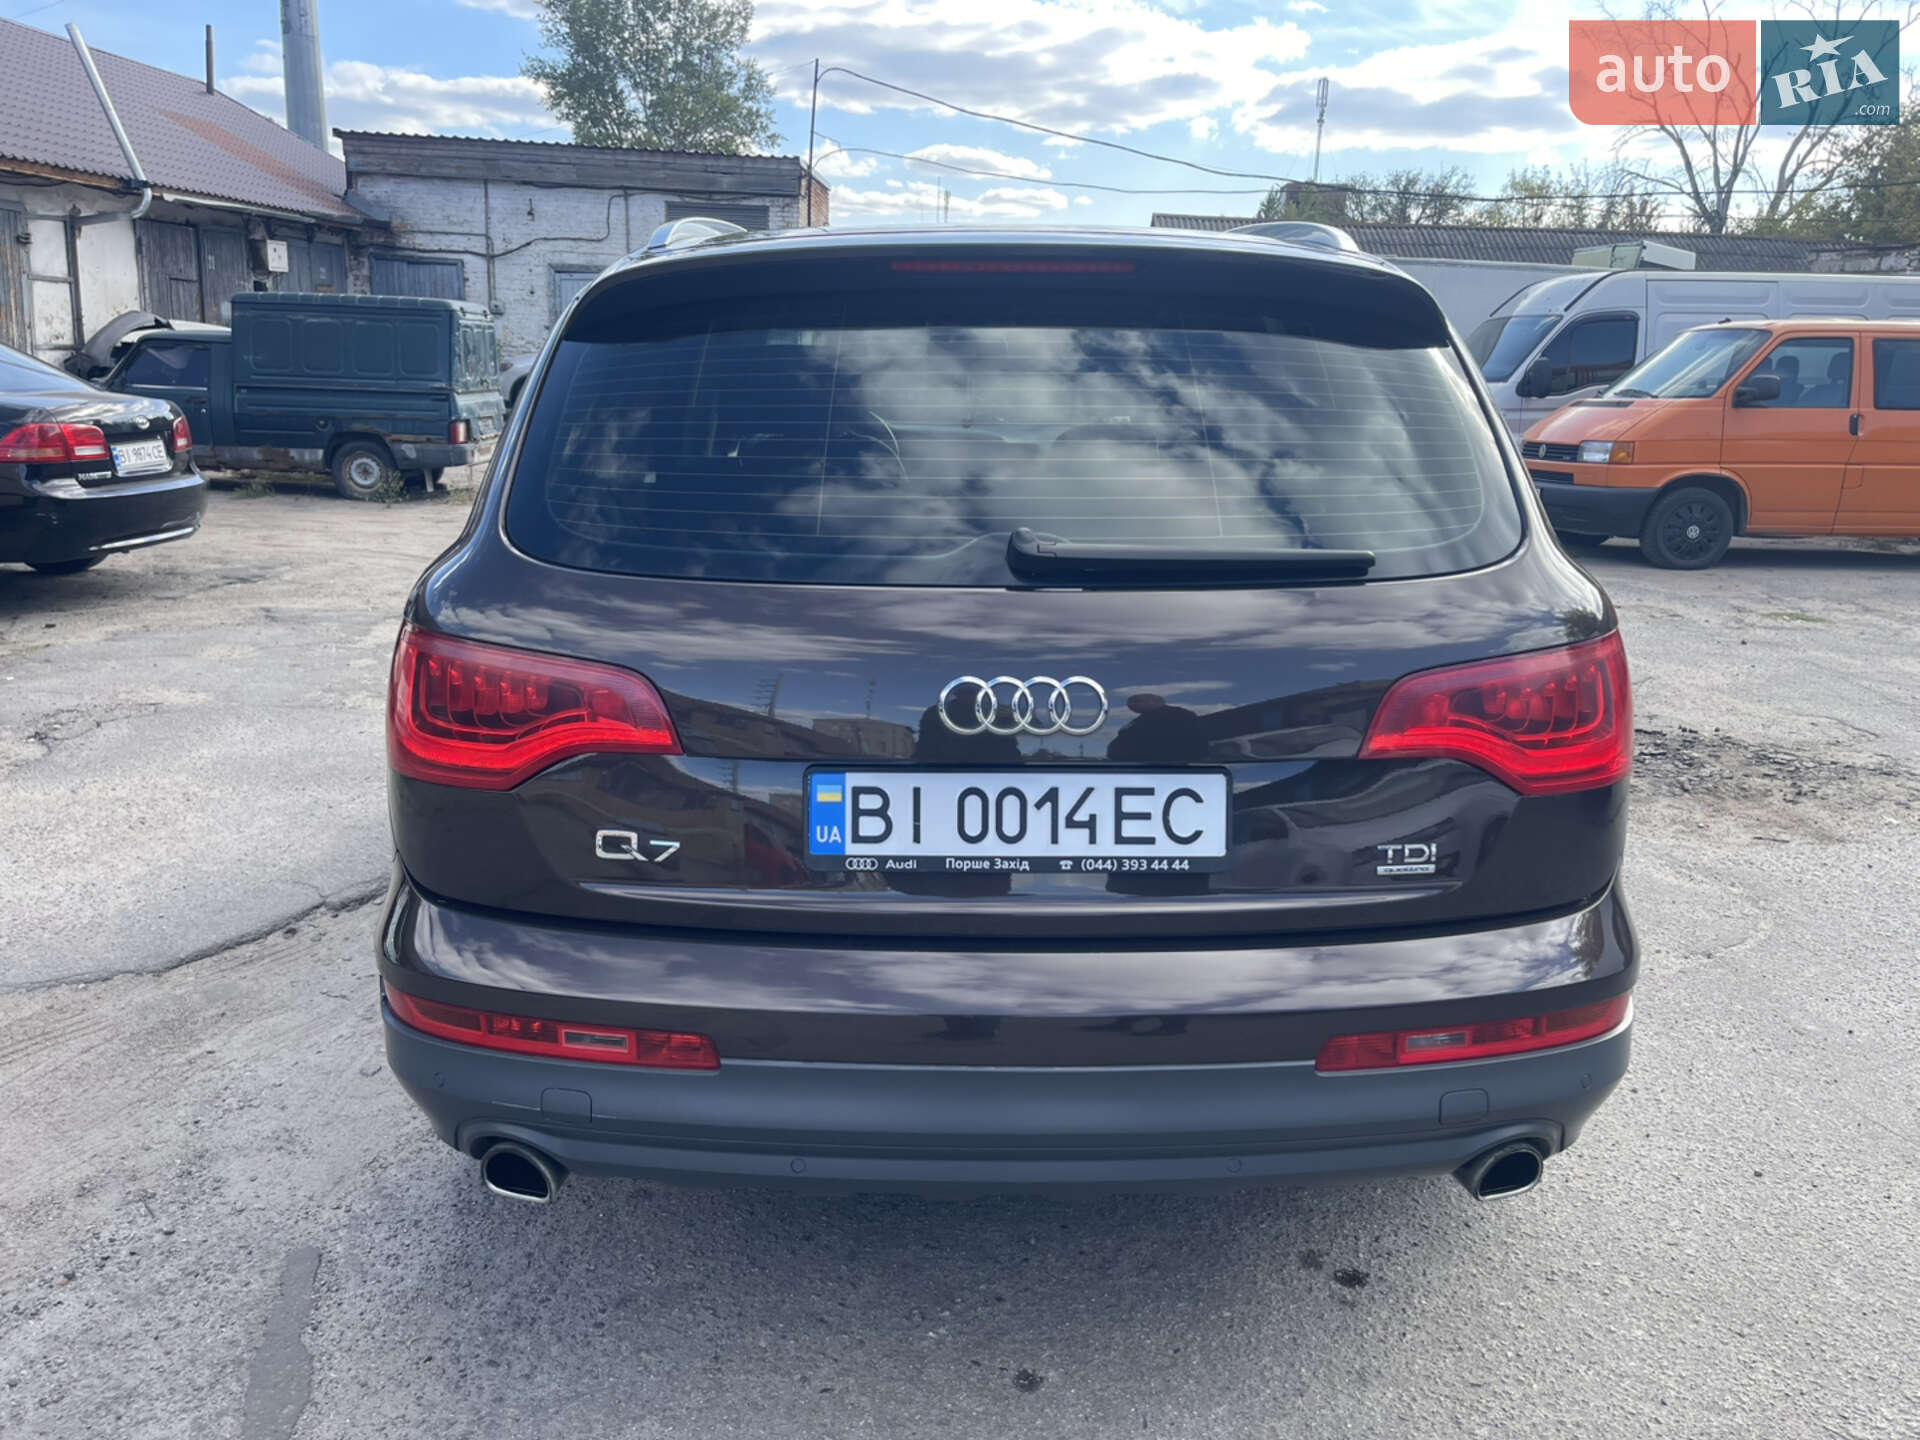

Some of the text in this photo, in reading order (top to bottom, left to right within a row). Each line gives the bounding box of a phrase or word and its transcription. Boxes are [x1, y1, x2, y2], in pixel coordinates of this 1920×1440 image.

[851, 786, 921, 844] BI
[816, 825, 842, 843] UA
[595, 829, 681, 862] Q7
[1377, 843, 1437, 864] TDI
[885, 858, 918, 870] Audi
[945, 858, 1030, 872] Порше Захід
[1081, 858, 1190, 872] (044) 393 44 44
